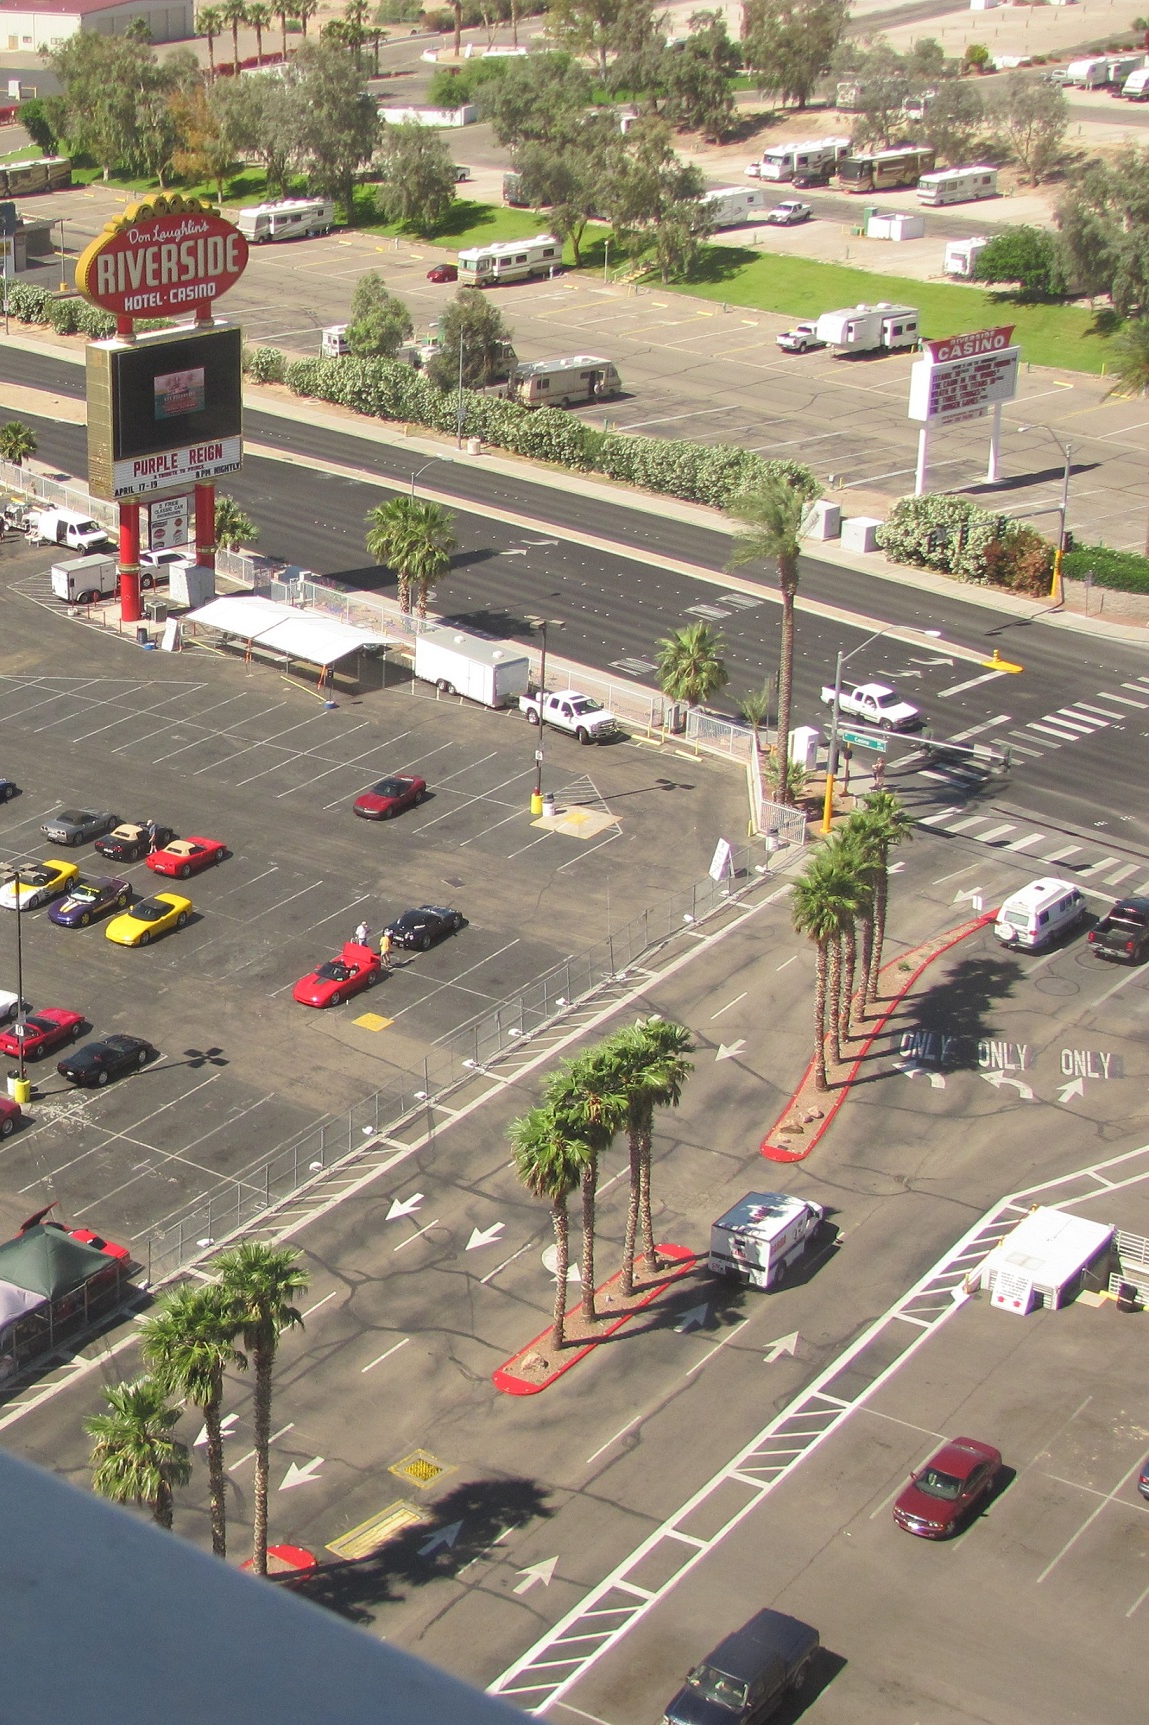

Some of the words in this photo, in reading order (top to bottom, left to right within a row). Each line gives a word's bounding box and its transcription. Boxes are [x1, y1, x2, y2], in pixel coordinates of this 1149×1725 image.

[126, 228, 151, 245] Don
[152, 219, 209, 242] Laughlin's
[97, 233, 239, 296] RIVERSIDE
[124, 291, 162, 311] HOTEL
[169, 282, 216, 303] CASINO
[938, 335, 1005, 360] CASINO
[950, 331, 995, 345] RIVERSIDE
[133, 453, 178, 477] PURPLE
[189, 443, 223, 465] REIGN
[214, 462, 240, 474] NIGHTLY
[114, 486, 134, 497] APRIL
[139, 481, 158, 491] 17-19
[164, 500, 179, 508] FREE
[900, 1030, 951, 1061] ONLY
[977, 1040, 1028, 1071] ONLY
[1061, 1048, 1110, 1079] ONLY
